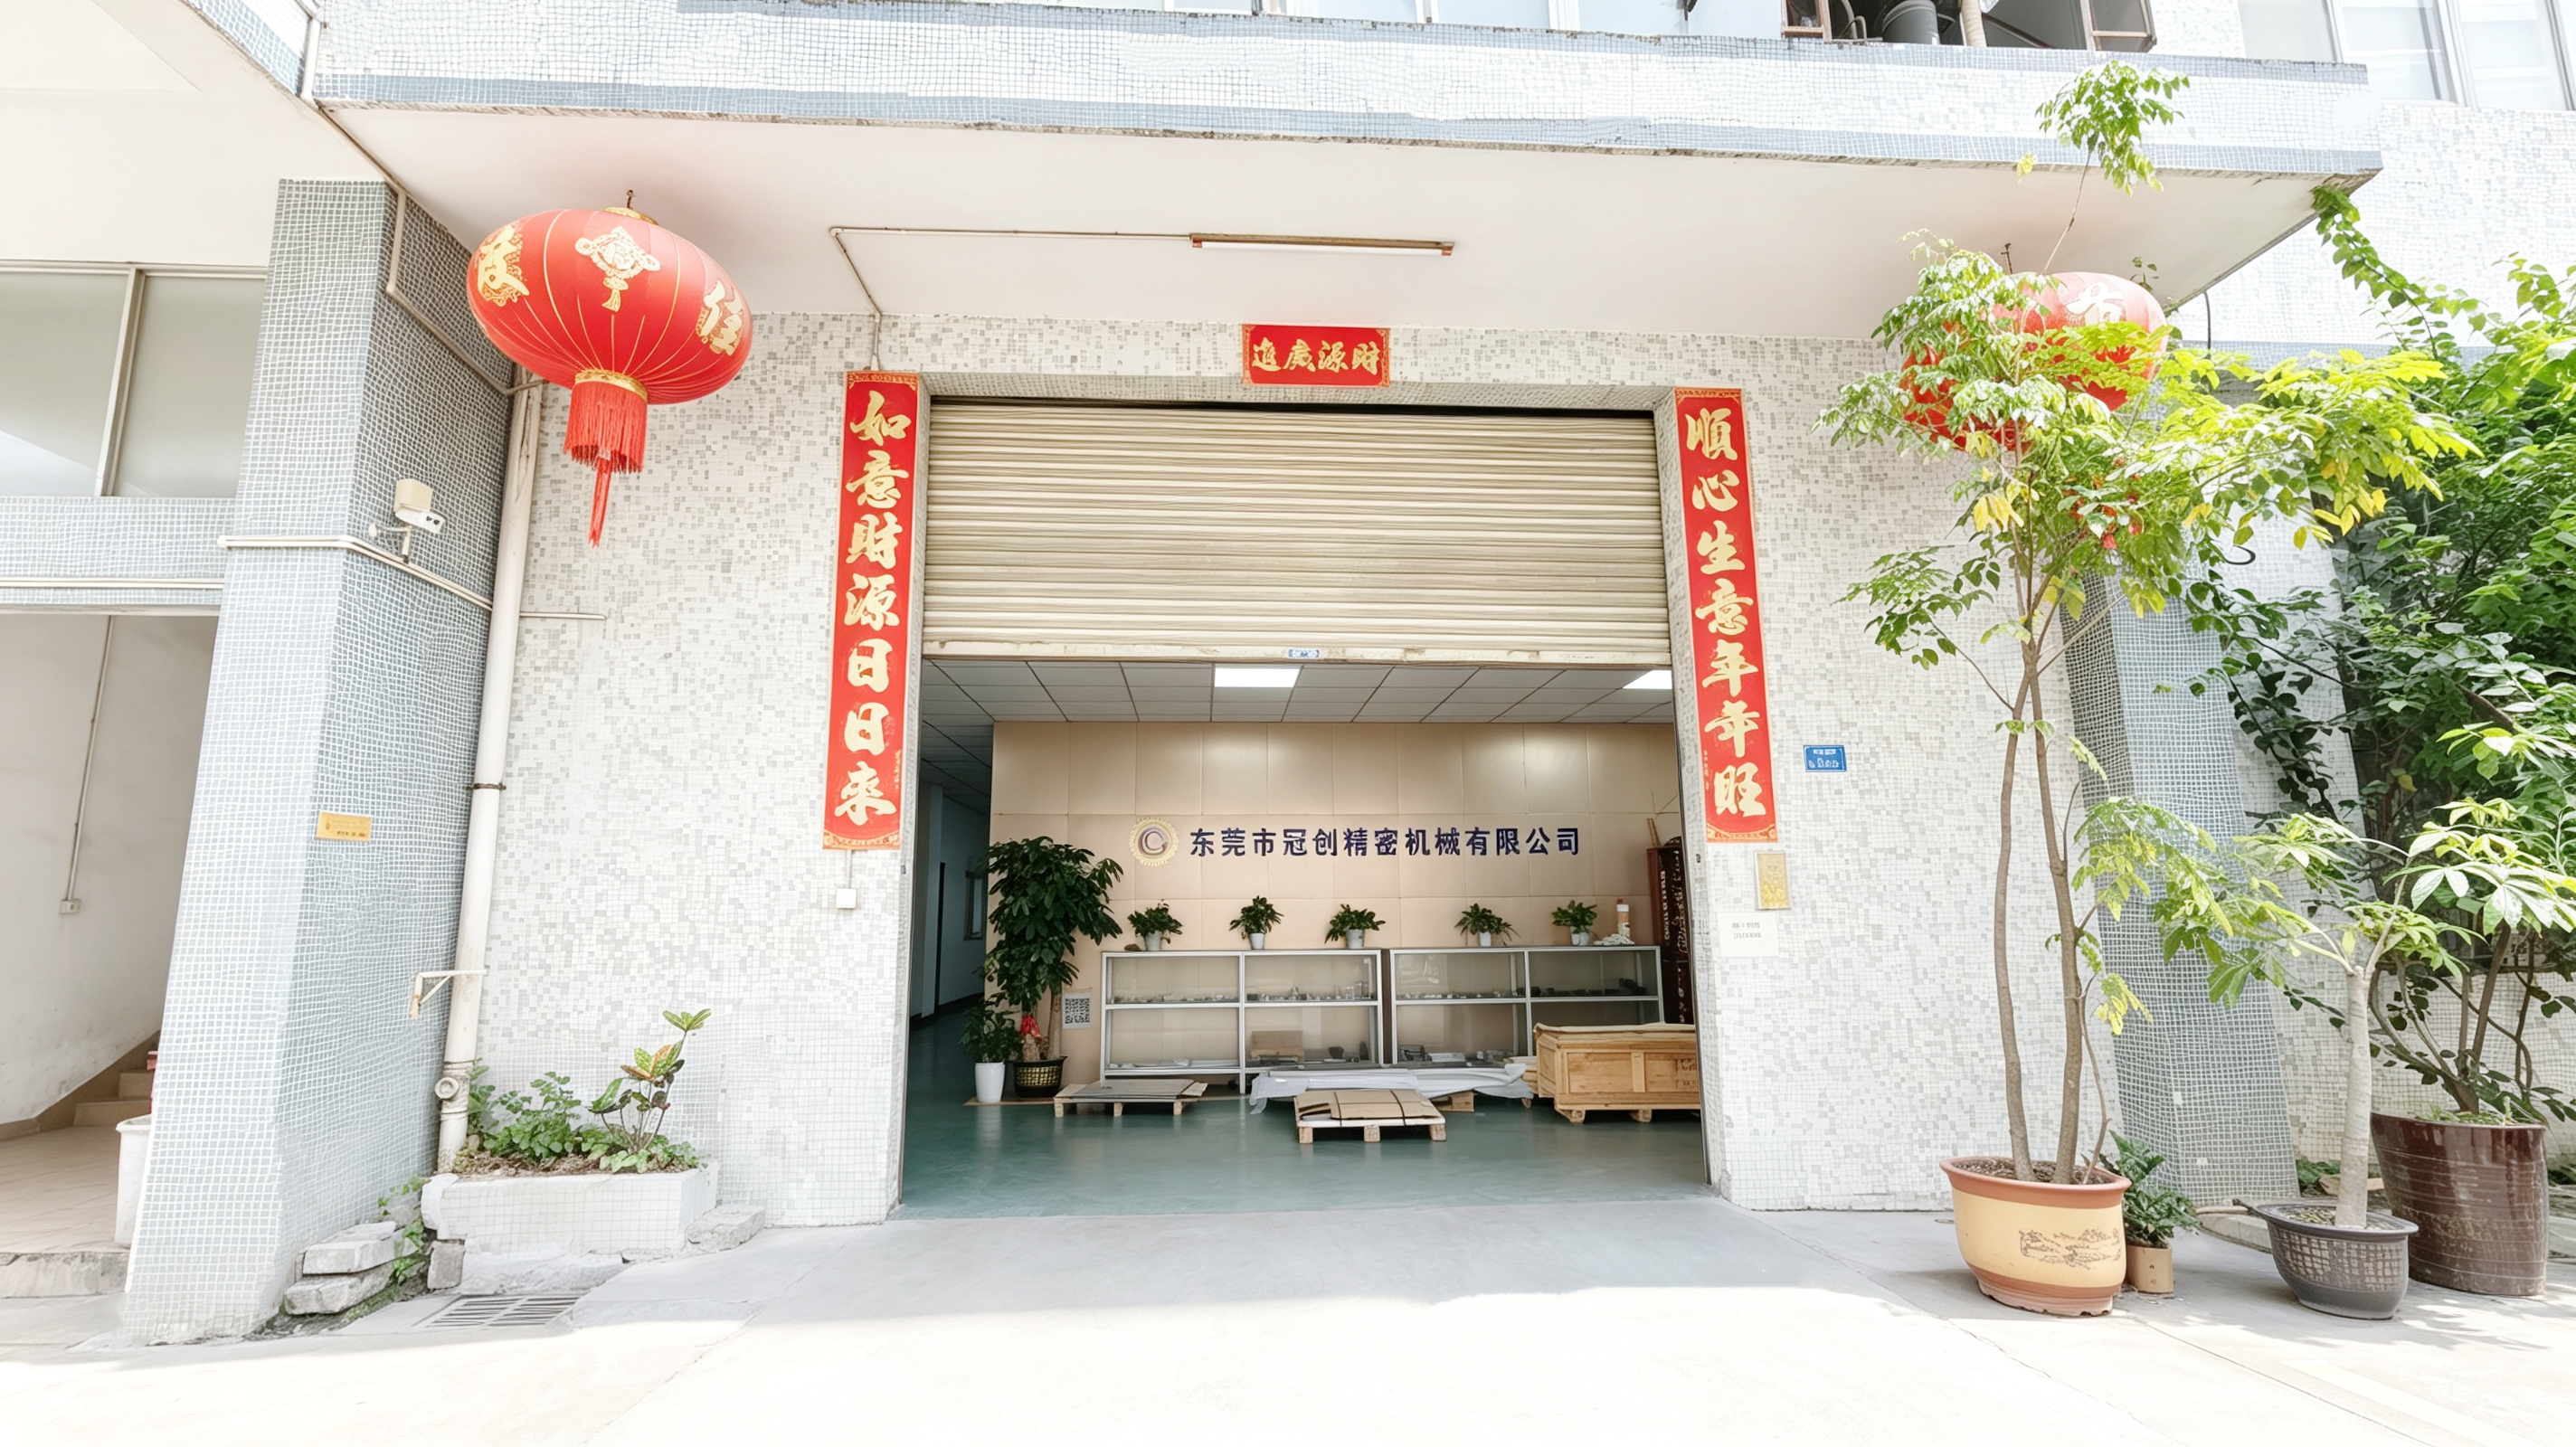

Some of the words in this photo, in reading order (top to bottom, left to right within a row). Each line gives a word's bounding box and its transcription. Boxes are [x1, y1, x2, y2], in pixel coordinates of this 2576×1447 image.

[1190, 827, 1578, 856] 东莞市冠创精密机械有限公司
